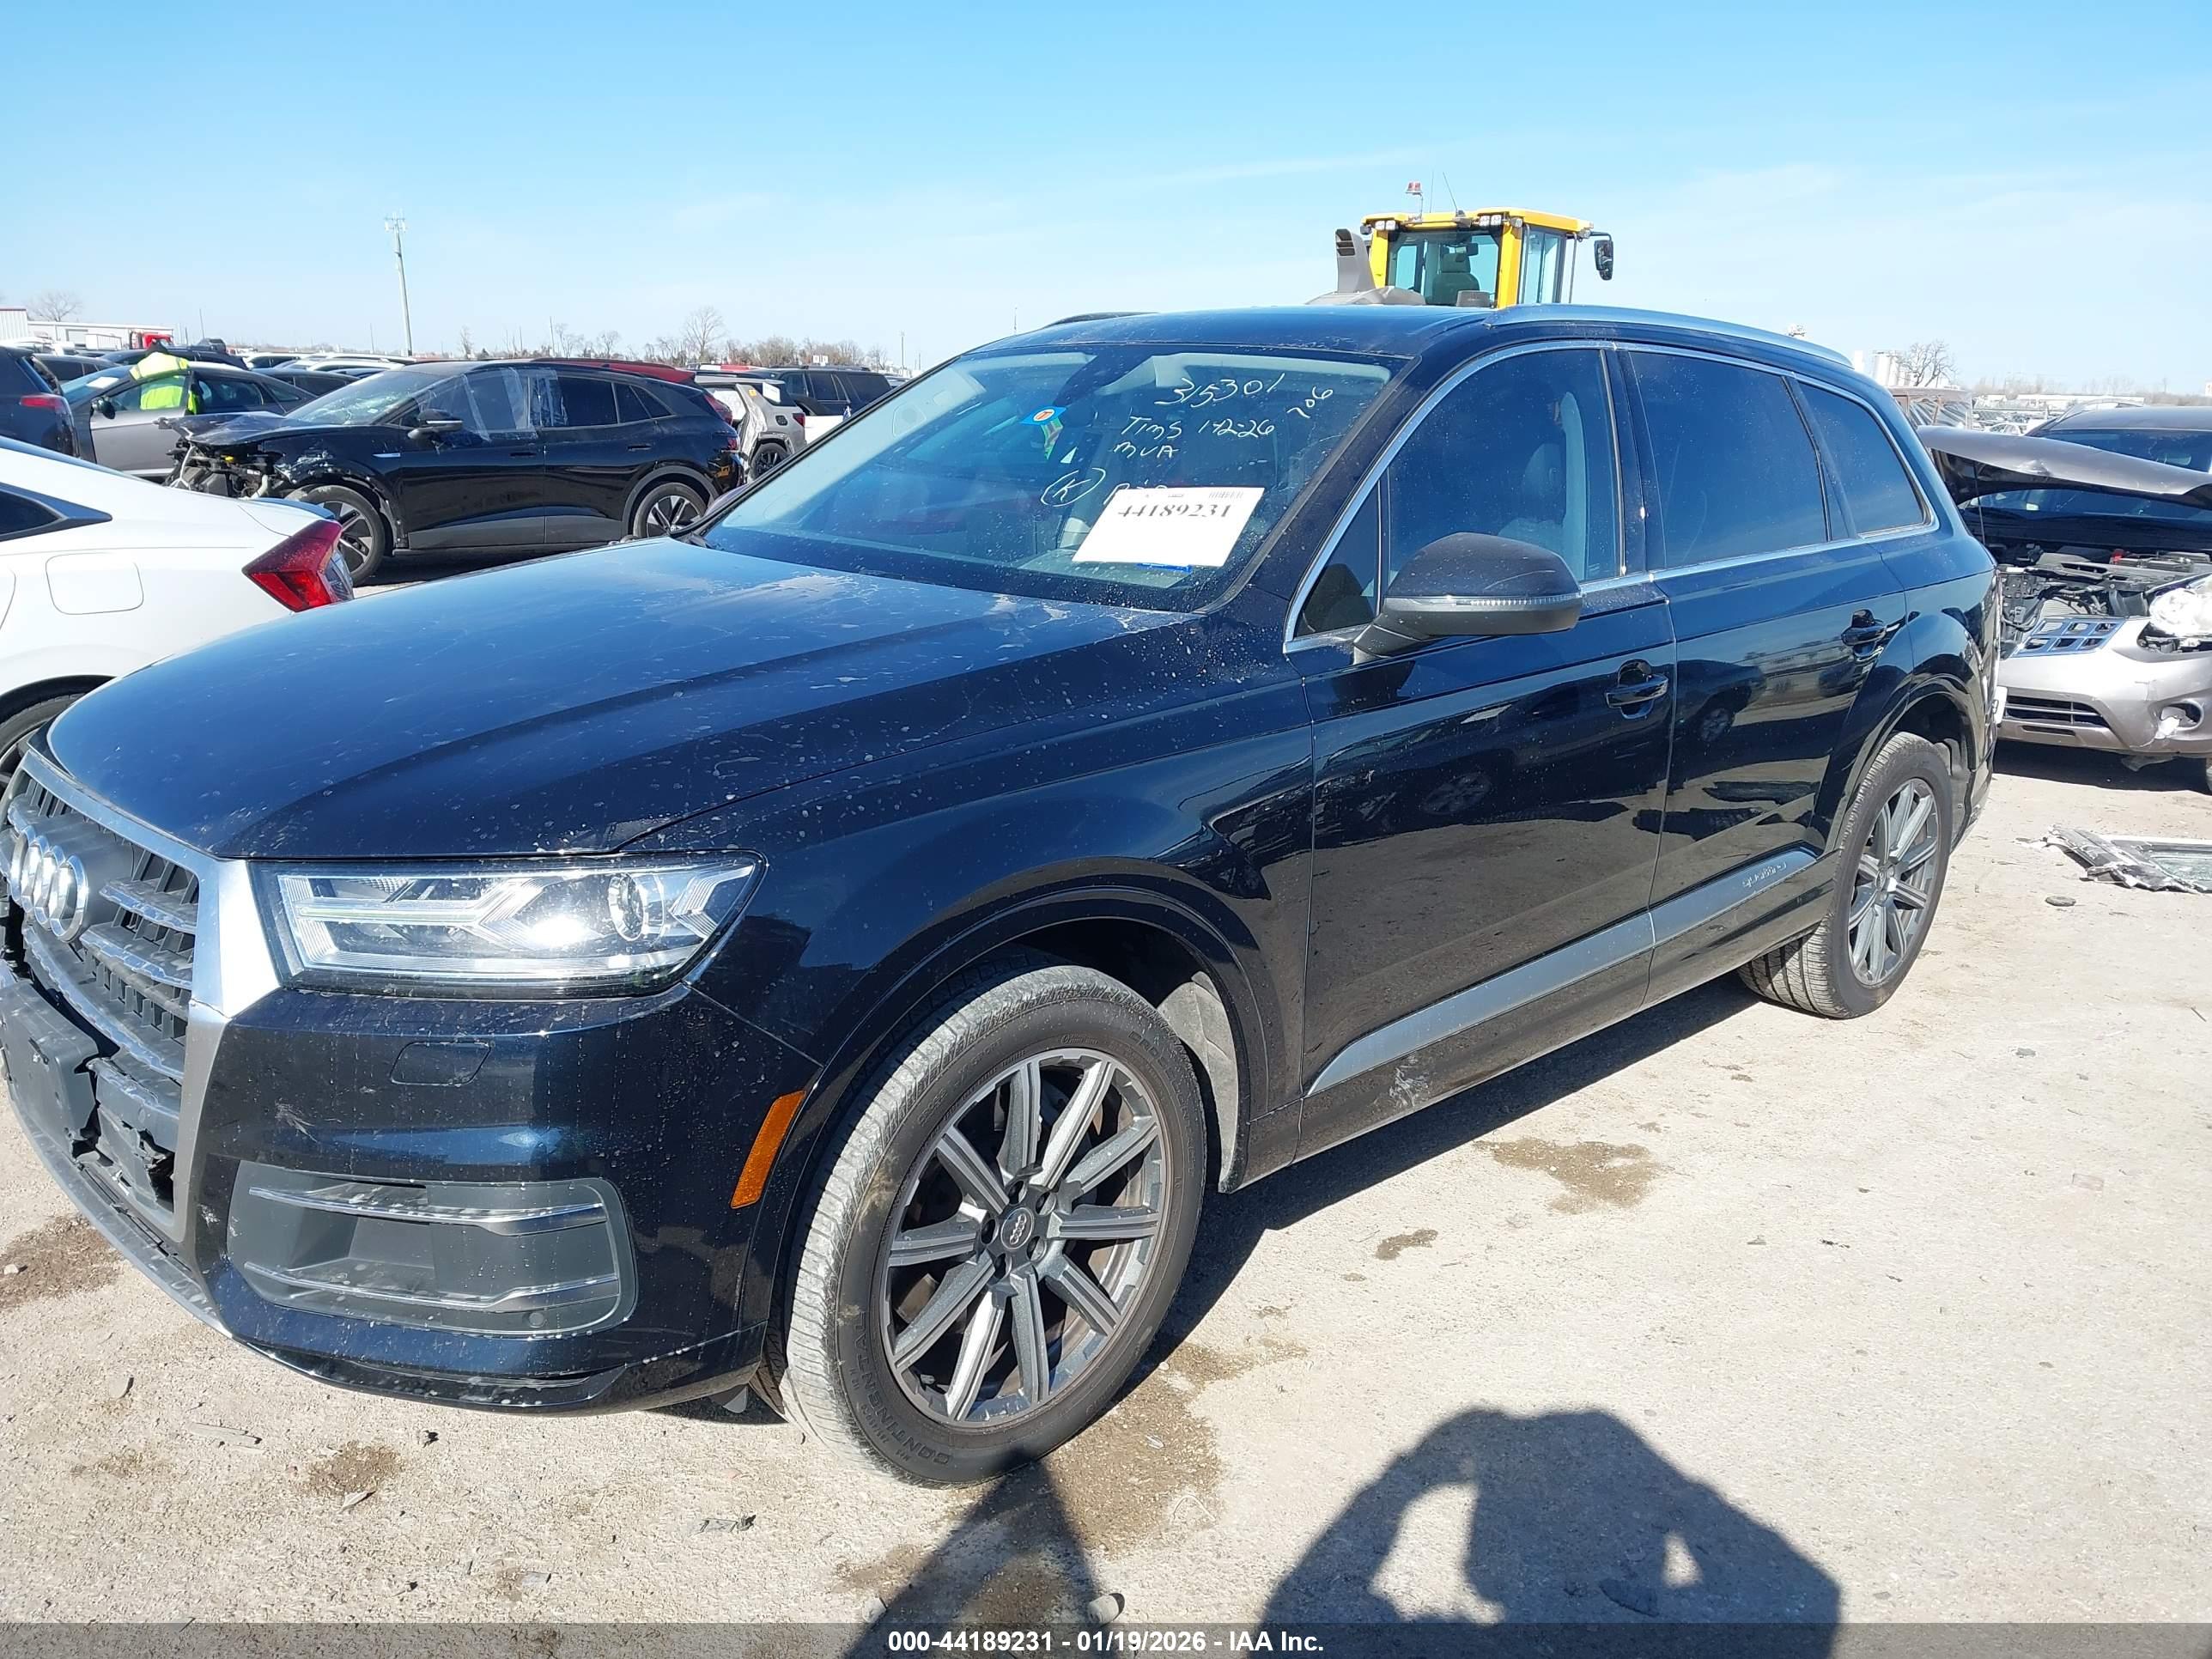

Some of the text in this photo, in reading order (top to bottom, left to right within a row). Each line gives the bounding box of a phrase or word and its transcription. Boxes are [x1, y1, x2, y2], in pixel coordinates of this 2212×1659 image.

[1153, 372, 1286, 409] 315301
[1118, 503, 1231, 518] 44189231
[854, 1310, 954, 1466] CONTINENTAL
